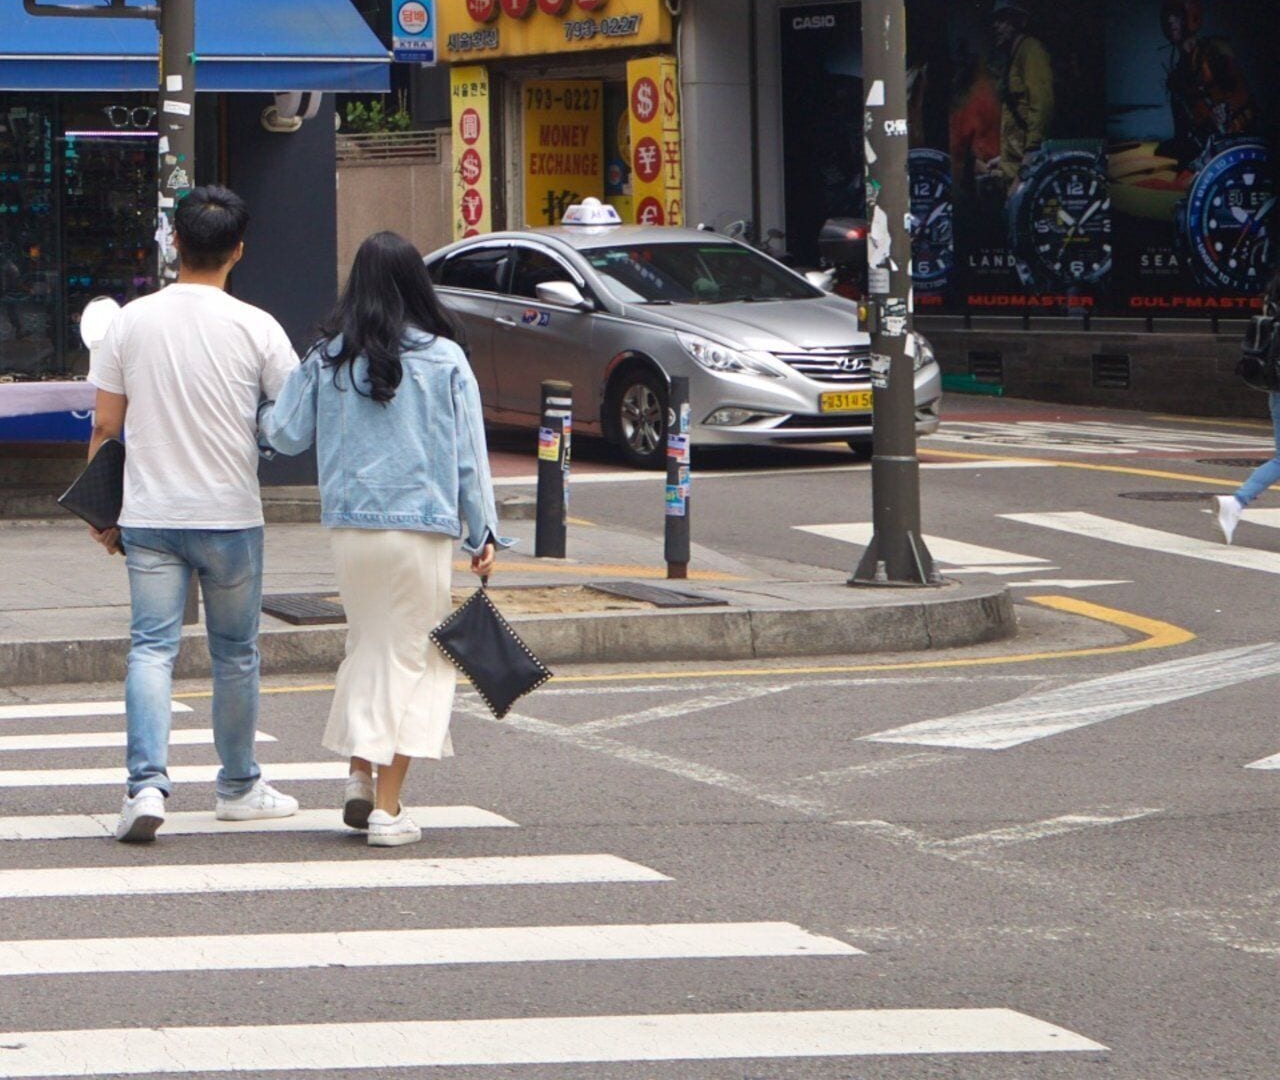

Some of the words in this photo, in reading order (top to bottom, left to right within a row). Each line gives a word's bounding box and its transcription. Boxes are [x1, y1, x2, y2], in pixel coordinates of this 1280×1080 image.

[402, 11, 425, 24] 담배
[793, 16, 836, 29] CASIO
[563, 14, 641, 41] 793-0227
[453, 82, 487, 98] 서울환전
[526, 89, 600, 110] 793-0227
[540, 125, 589, 147] MONEY
[530, 154, 599, 177] EXCHANGE
[969, 254, 1016, 267] LAND
[1140, 254, 1178, 266] SEA
[968, 295, 1093, 307] MUDMASTER
[1130, 296, 1268, 308] GULFMASTE
